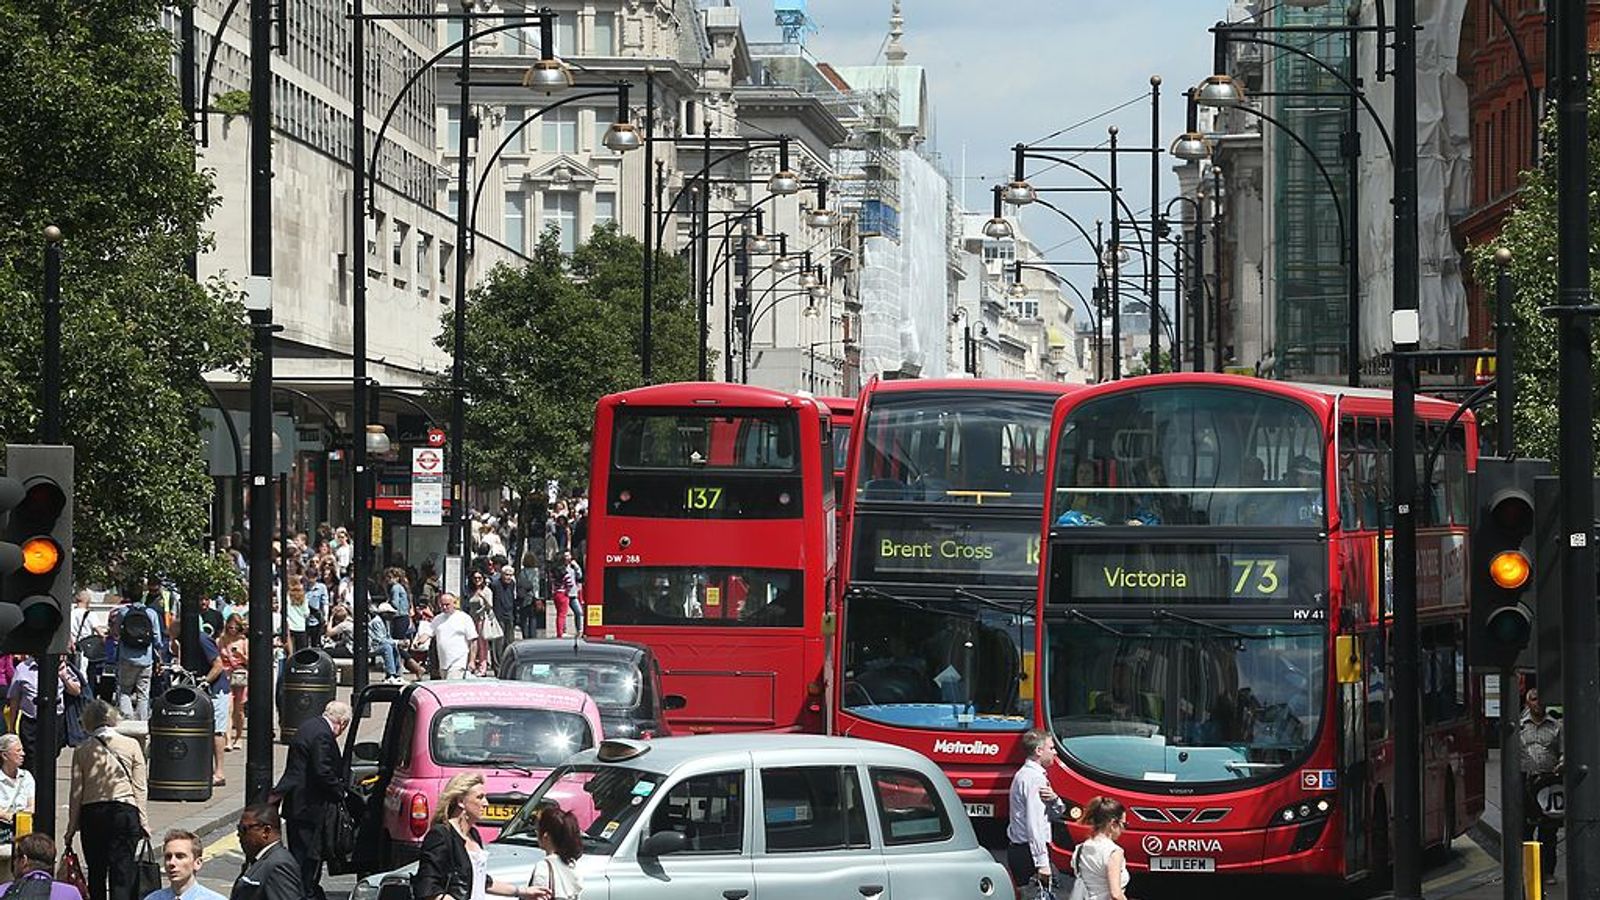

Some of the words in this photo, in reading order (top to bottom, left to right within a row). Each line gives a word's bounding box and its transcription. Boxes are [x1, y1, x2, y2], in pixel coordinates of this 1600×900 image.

[429, 434, 443, 442] OF
[688, 487, 722, 509] 137
[881, 539, 932, 558] Brent
[940, 540, 993, 559] Cross
[606, 554, 623, 563] DW
[626, 554, 640, 563] 288
[1103, 566, 1187, 588] Victoria
[1232, 559, 1278, 594] 73
[1293, 609, 1310, 619] HV
[1312, 609, 1324, 619] 41
[933, 739, 999, 755] Metroline
[970, 804, 990, 815] AFN
[1166, 839, 1223, 852] ARRIVA
